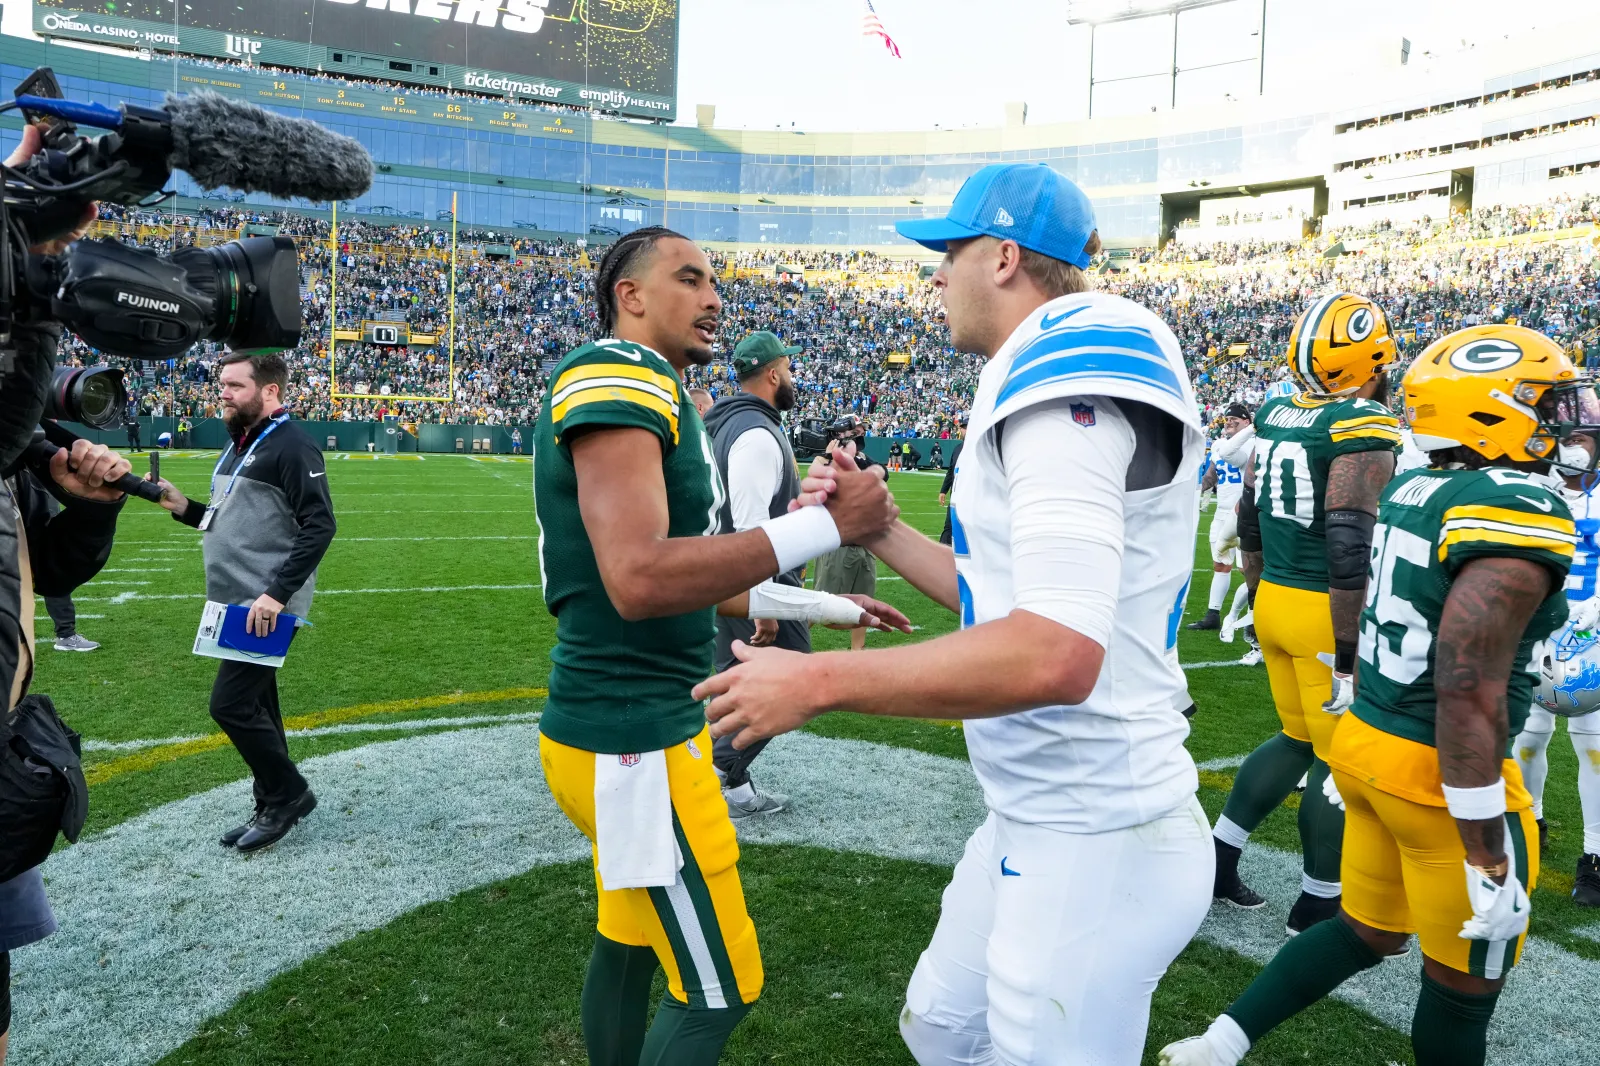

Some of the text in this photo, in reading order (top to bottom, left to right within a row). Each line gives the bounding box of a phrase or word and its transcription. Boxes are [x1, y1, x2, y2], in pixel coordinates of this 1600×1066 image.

[43, 14, 180, 45] ONEIDA CASINO HOTEL
[225, 34, 262, 56] Lite
[181, 75, 241, 89] RETIRED NUMBERS
[273, 81, 286, 91] 14
[464, 72, 562, 98] ticketmaster
[274, 92, 300, 100] HUTSON
[337, 89, 345, 99] 3
[317, 97, 334, 105] TONY
[393, 96, 405, 106] 15
[579, 88, 670, 111] emplify HEALTH
[381, 105, 397, 113] BART
[447, 104, 461, 113] 66
[503, 111, 516, 120] 92
[511, 121, 529, 129] WHITE
[554, 117, 562, 126] 4
[117, 291, 180, 314] FUJINON
[1450, 338, 1523, 373] G
[620, 752, 640, 766] NFL
